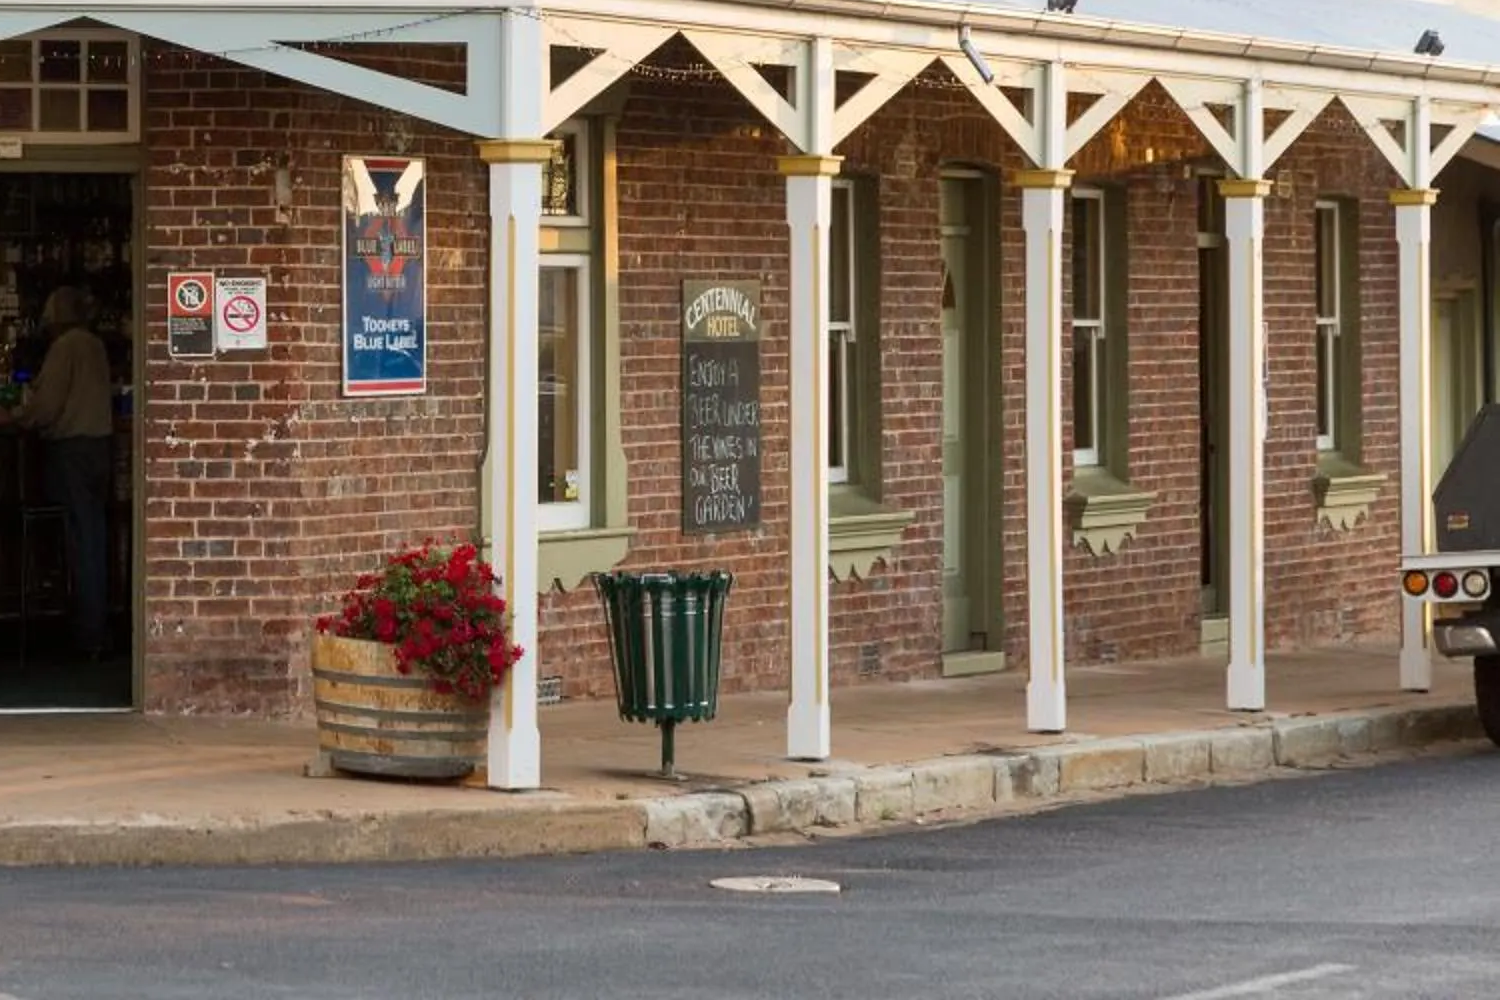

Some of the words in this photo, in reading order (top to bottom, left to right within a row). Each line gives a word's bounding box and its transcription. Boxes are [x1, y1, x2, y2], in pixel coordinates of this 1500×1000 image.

[685, 287, 757, 331] CENTENNIAL
[362, 316, 410, 333] TOOHEYS
[707, 315, 741, 337] HOTEL
[354, 334, 384, 351] BLUE
[385, 330, 419, 351] LABEL
[709, 463, 742, 495] BEER
